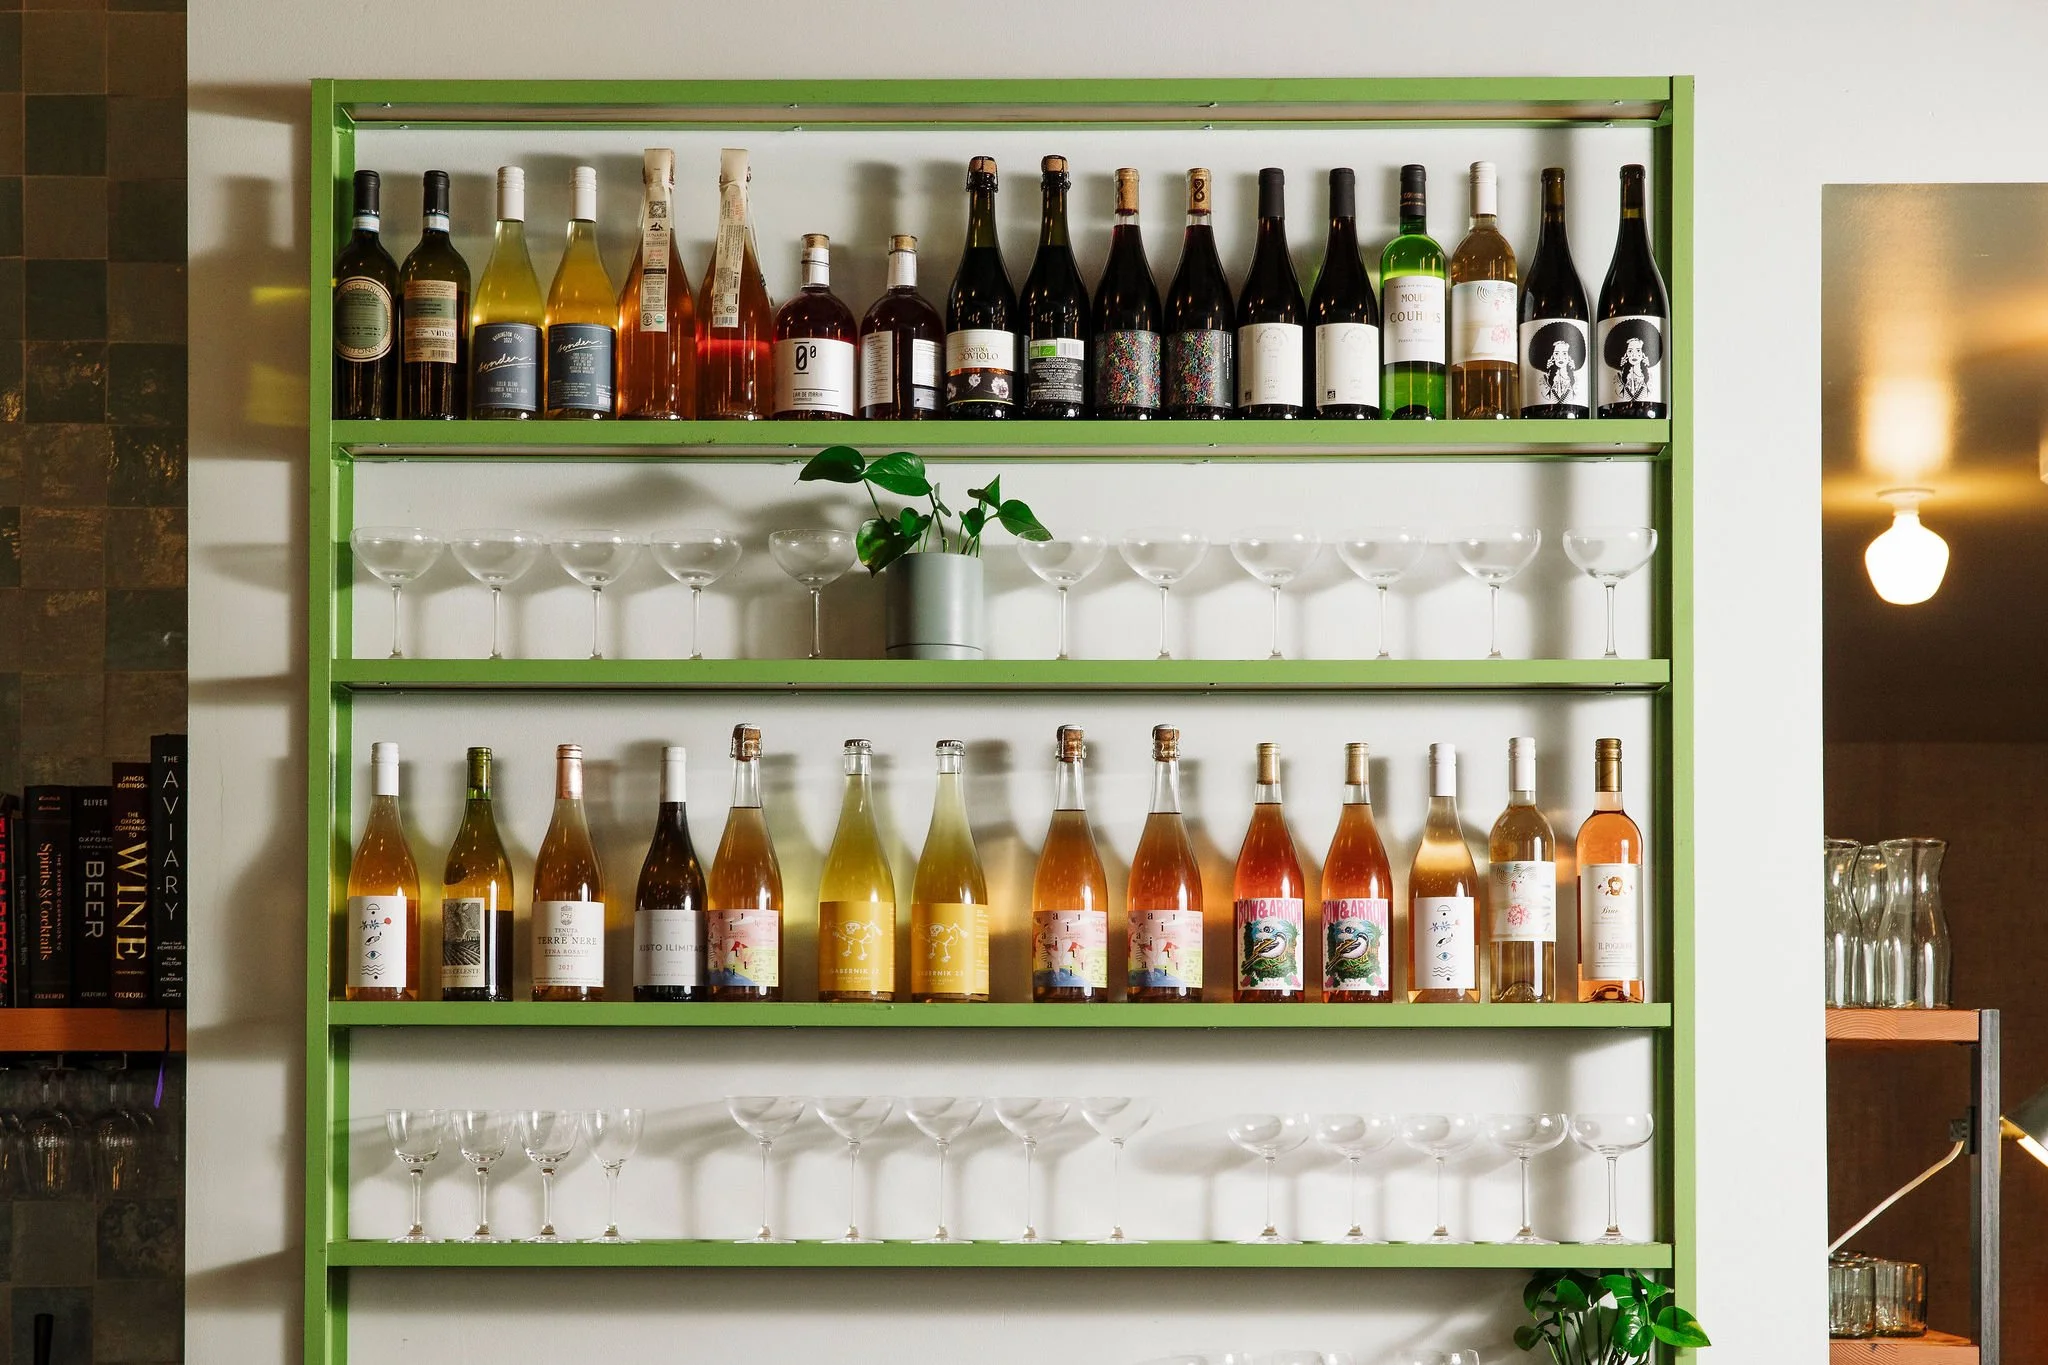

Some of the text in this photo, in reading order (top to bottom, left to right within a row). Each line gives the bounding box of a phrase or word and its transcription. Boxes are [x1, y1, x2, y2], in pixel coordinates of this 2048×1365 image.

[1390, 311, 1441, 323] COUHS
[161, 755, 180, 763] THE
[162, 769, 180, 921] AVIARY
[37, 843, 54, 961] Spirits & Cocktails
[85, 861, 105, 938] BEER
[115, 841, 148, 960] WINE
[537, 937, 597, 945] TERRE NERE
[666, 944, 706, 952] ILIMITAD
